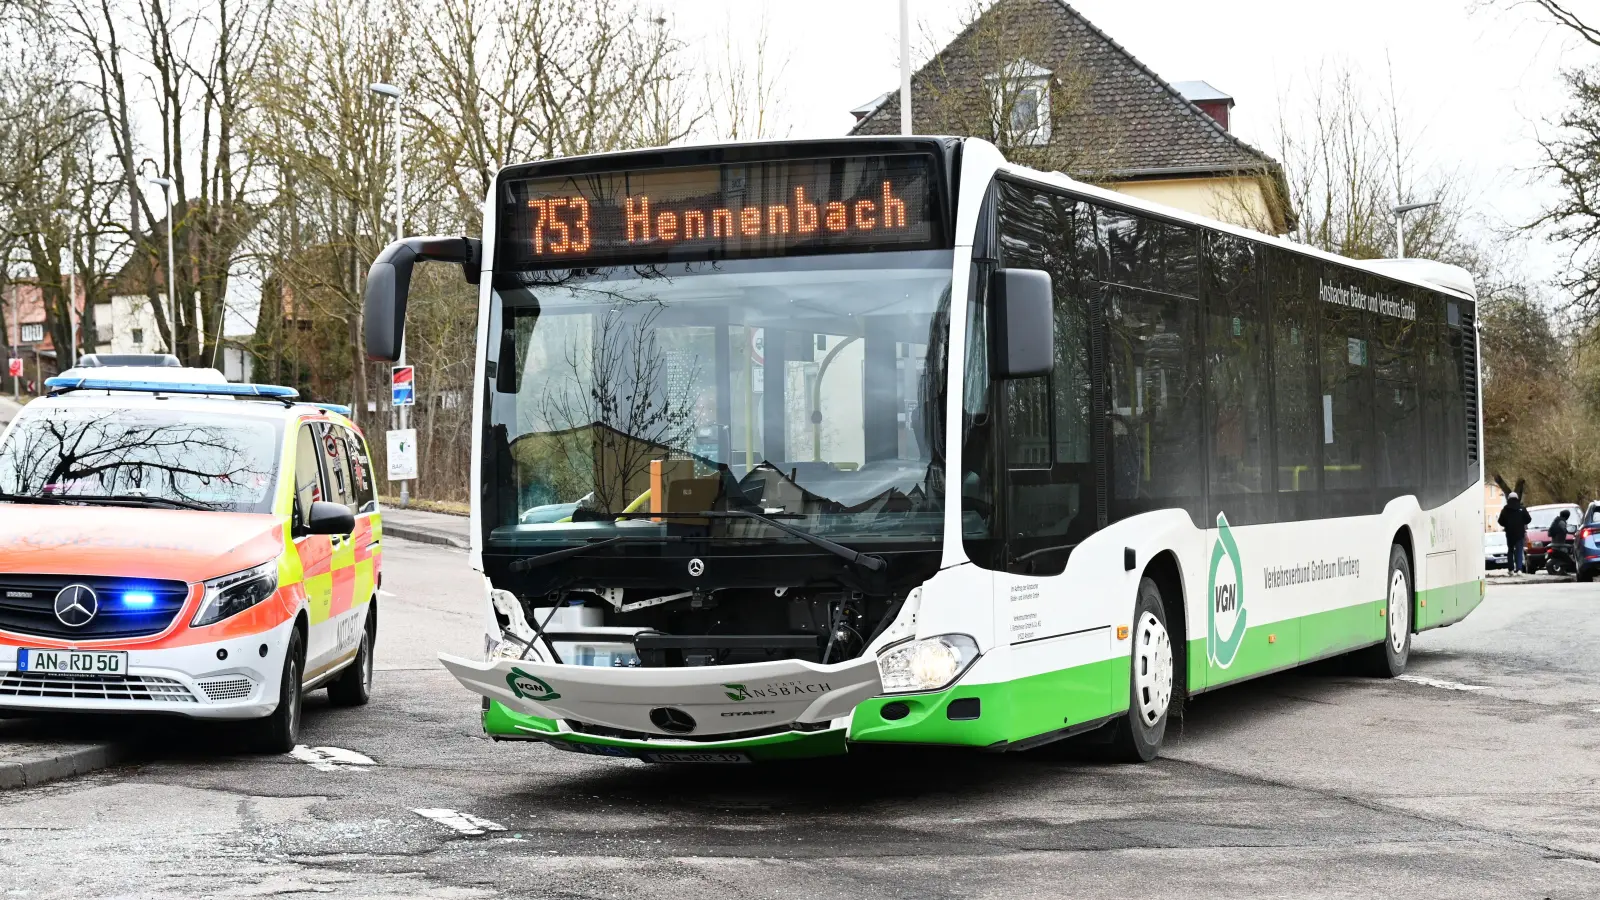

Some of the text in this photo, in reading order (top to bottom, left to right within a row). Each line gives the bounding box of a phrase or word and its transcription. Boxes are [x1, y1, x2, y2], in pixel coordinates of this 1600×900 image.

[528, 181, 905, 254] 753 Hennenbach
[1319, 277, 1416, 321] Ansbacher Bäder und Verkehrs GmbH
[1263, 555, 1360, 590] Verkehrsverbund Großraum Nürnberg
[1215, 583, 1236, 613] VGN
[35, 653, 119, 672] AN RD 50
[516, 682, 544, 692] VGN
[720, 709, 775, 717] CITARO
[659, 753, 683, 762] AN
